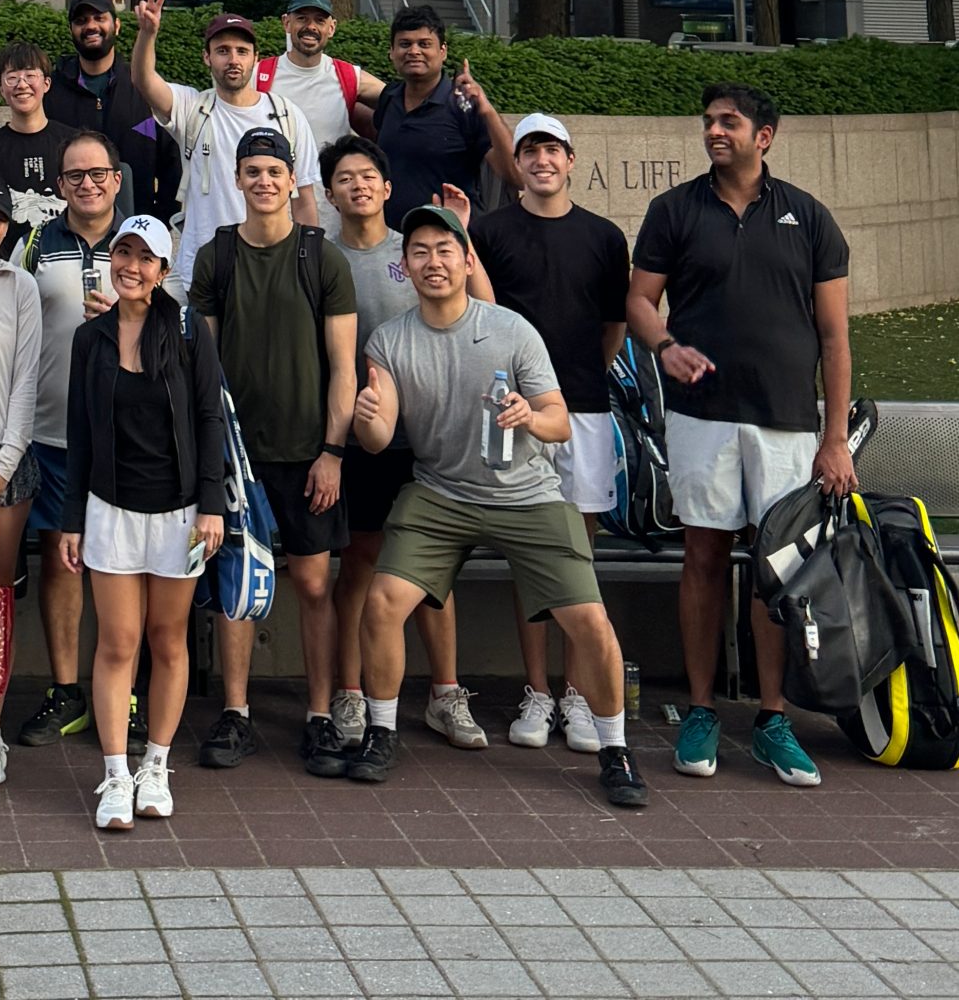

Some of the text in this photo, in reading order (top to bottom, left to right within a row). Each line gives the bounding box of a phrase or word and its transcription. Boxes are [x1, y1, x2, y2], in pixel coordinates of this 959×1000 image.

[587, 160, 681, 190] A LIFE
[131, 217, 151, 231] NY
